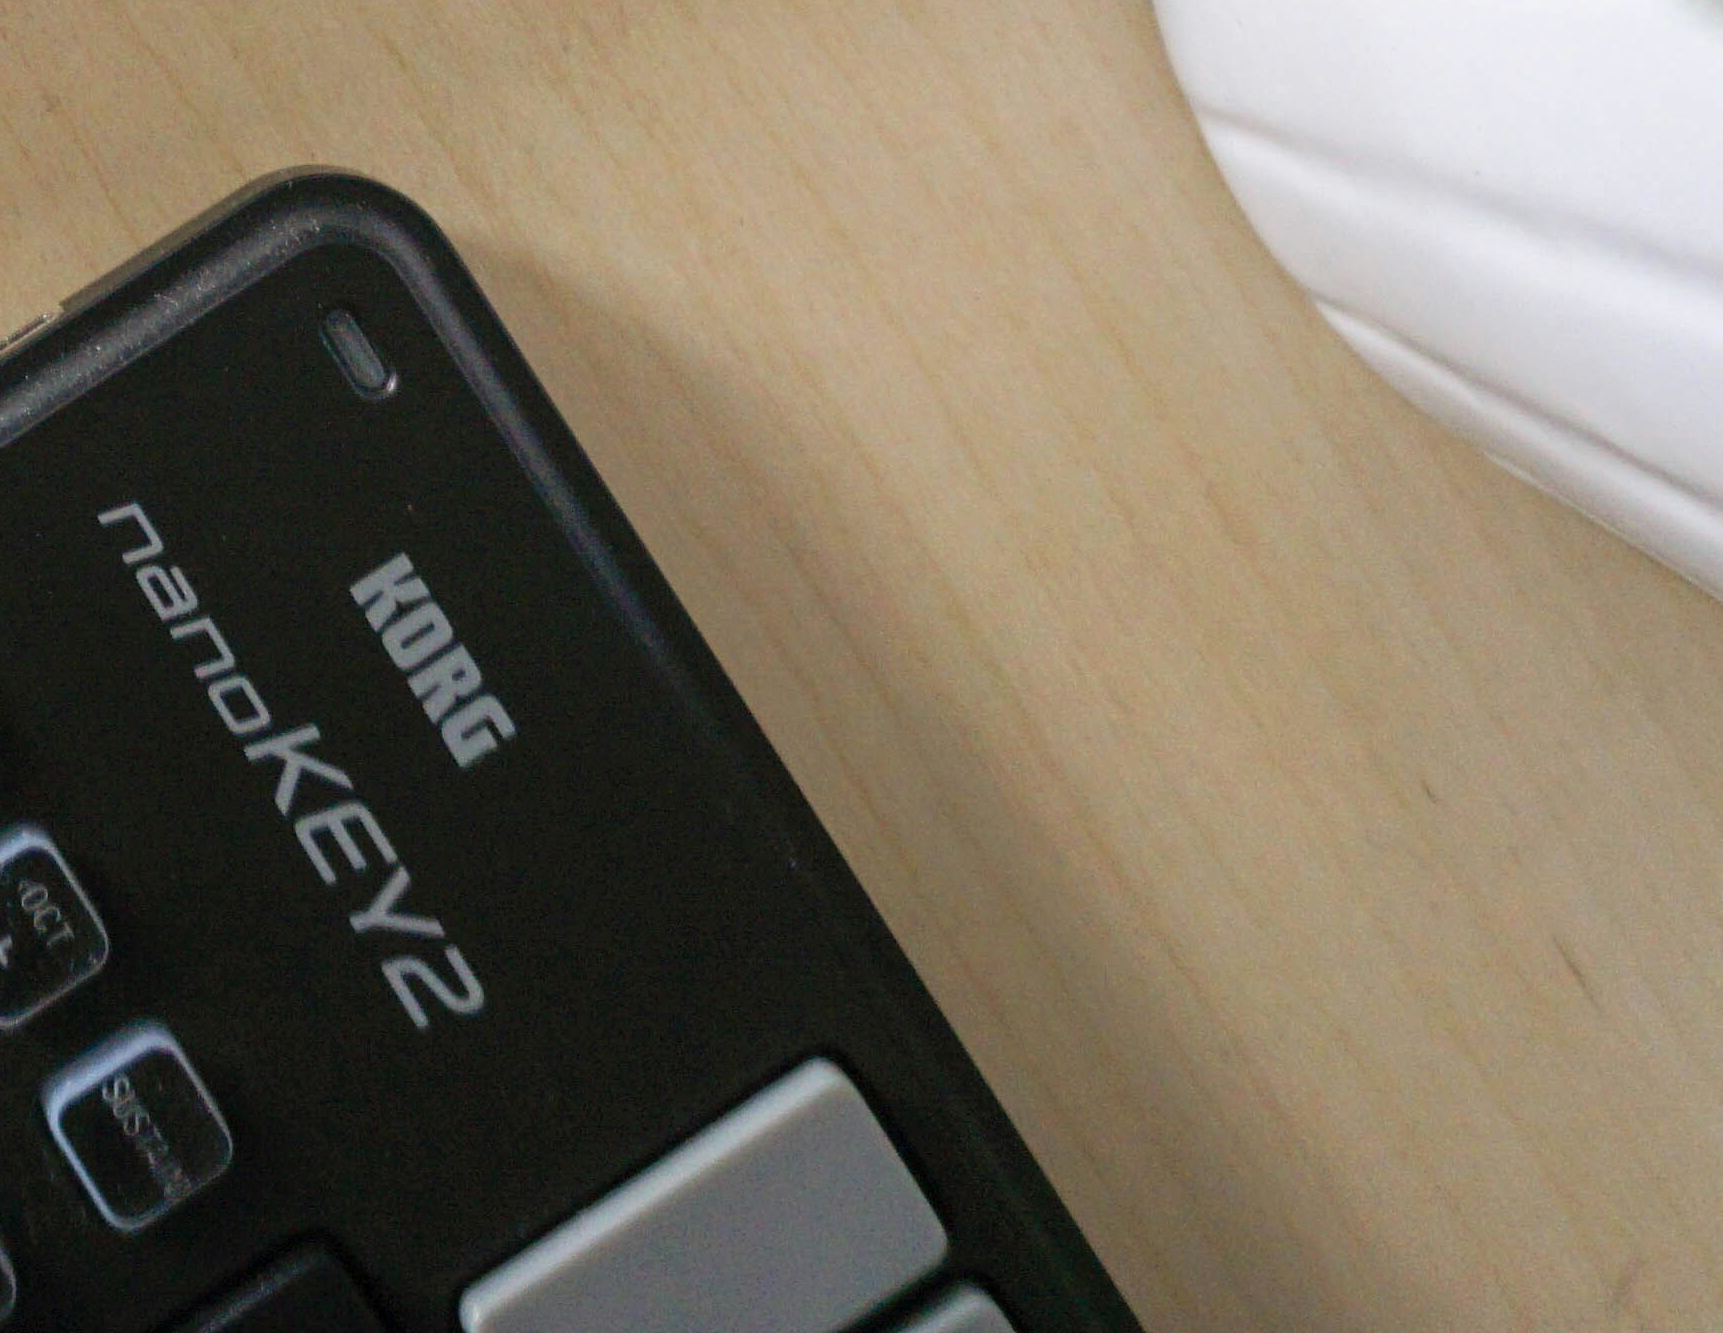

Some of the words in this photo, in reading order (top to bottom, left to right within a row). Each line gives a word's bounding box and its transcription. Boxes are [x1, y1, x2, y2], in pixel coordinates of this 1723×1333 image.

[97, 503, 485, 1030] nanoKEY2
[349, 552, 518, 769] KORG
[18, 879, 74, 948] OCT
